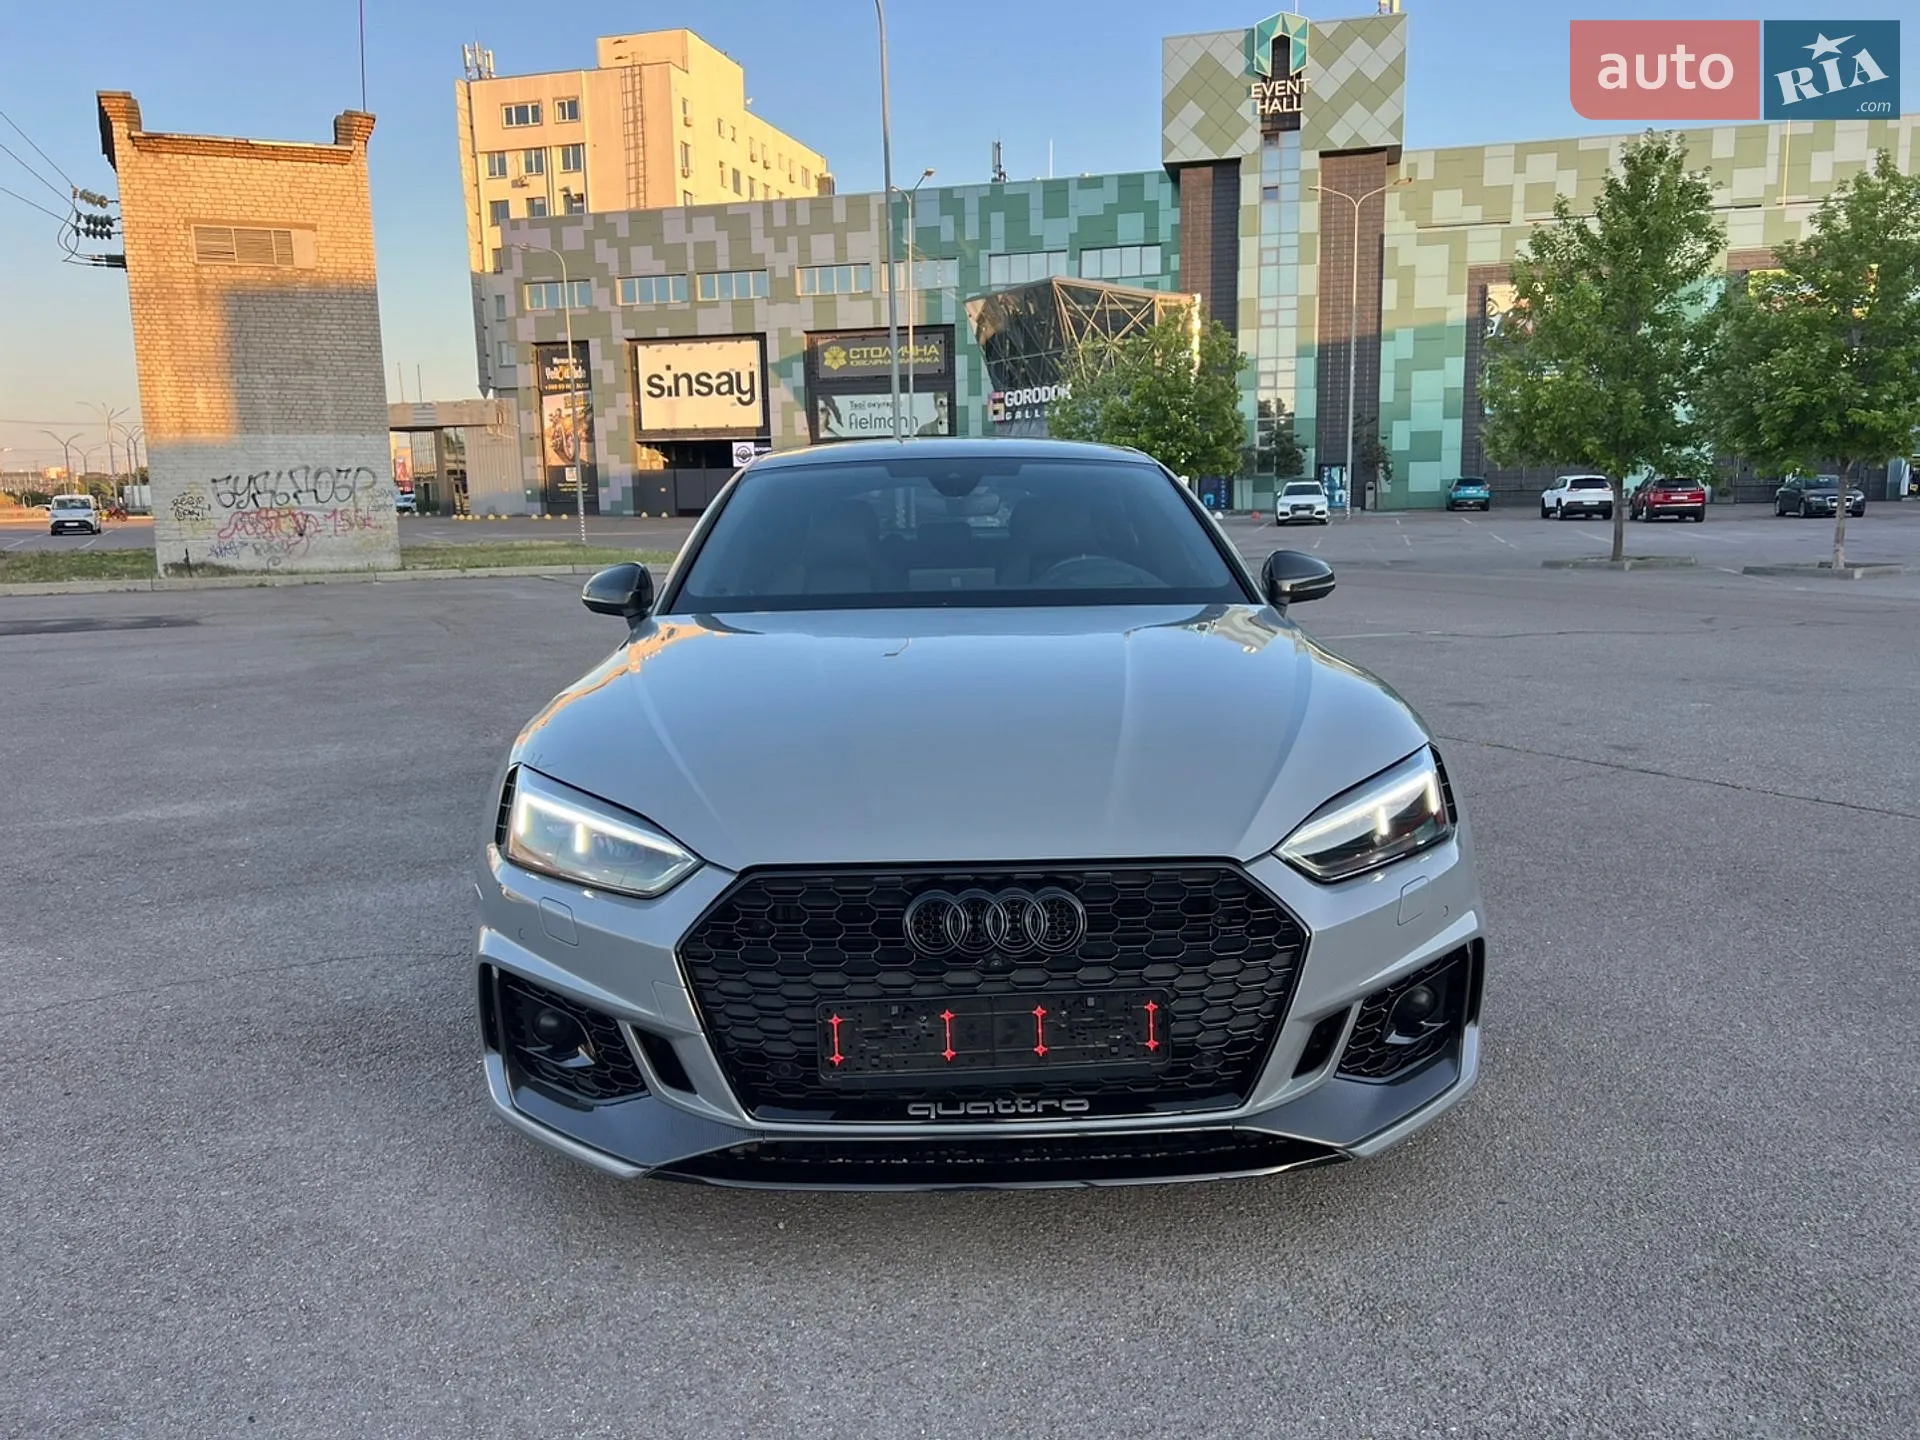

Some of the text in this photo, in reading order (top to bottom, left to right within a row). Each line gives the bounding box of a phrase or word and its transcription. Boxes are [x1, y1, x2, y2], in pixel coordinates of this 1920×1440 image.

[1251, 78, 1311, 98] EVENT
[1256, 94, 1304, 114] HALL
[646, 364, 756, 407] sinsay
[1005, 383, 1073, 407] GORODOK
[907, 1097, 1091, 1120] quattro
